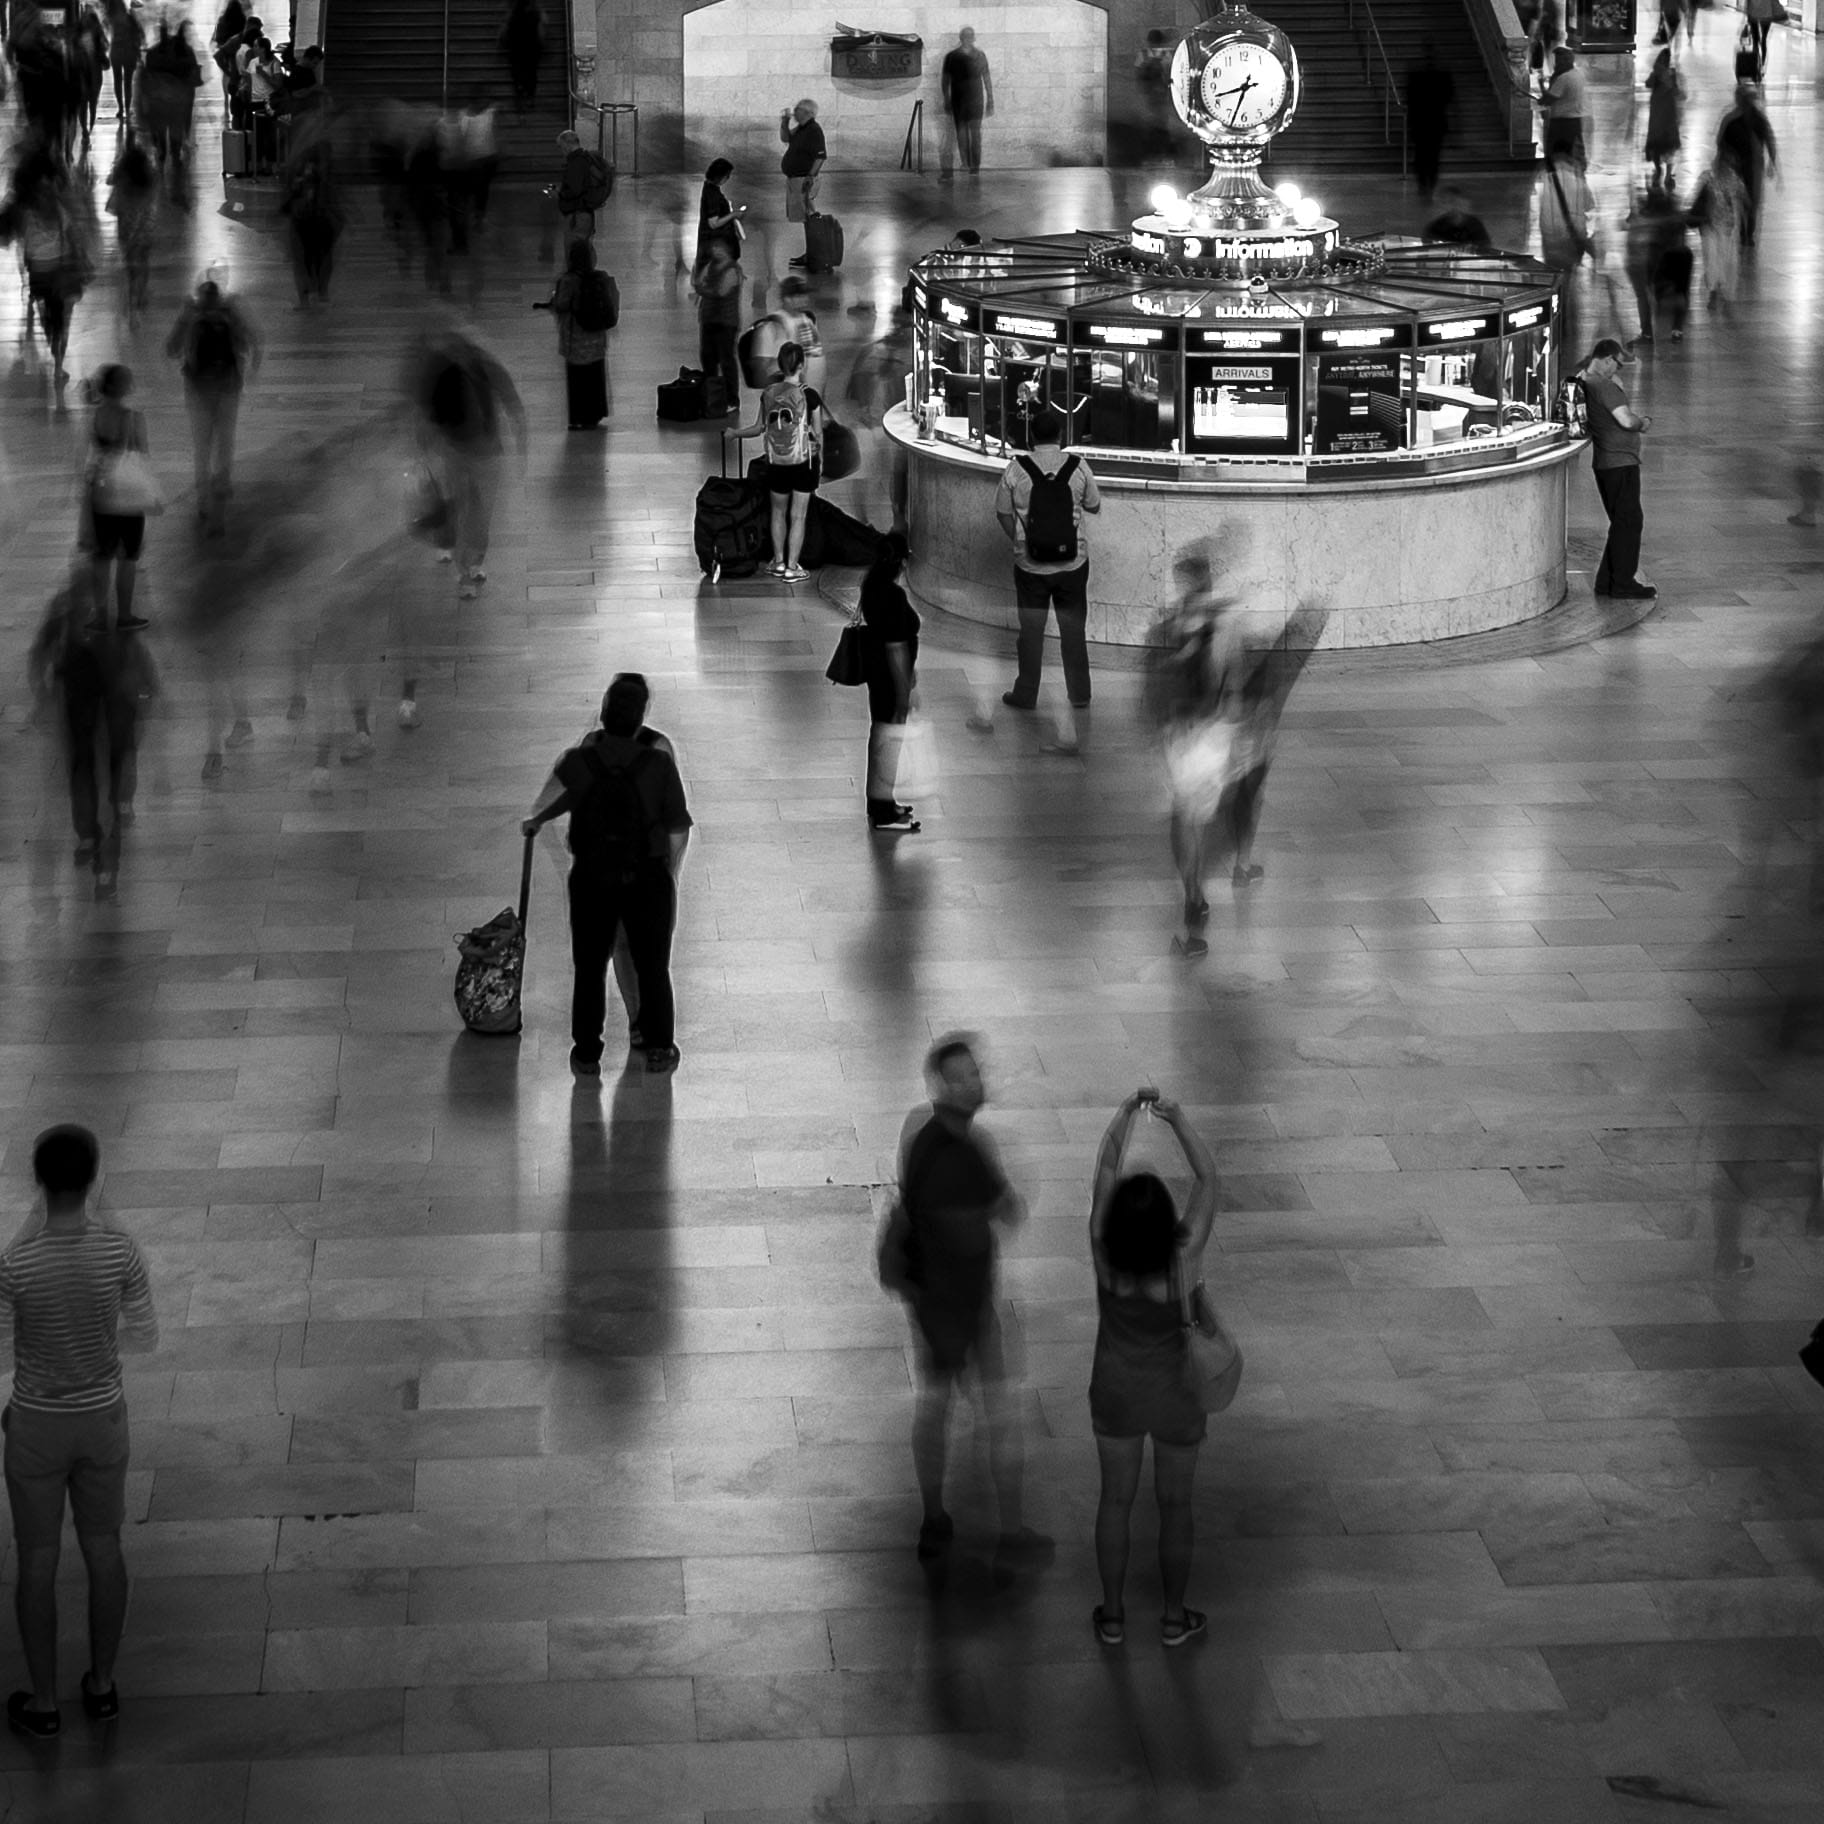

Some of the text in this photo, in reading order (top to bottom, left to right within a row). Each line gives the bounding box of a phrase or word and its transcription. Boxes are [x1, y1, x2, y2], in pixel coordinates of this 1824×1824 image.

[1224, 55, 1233, 67] 11
[1239, 50, 1249, 62] 12
[1212, 67, 1222, 79] 10
[1210, 81, 1217, 93] 9
[1226, 108, 1233, 118] 7
[1240, 112, 1249, 123] 6
[1215, 237, 1304, 259] Information
[1215, 368, 1270, 379] ARRIVALS
